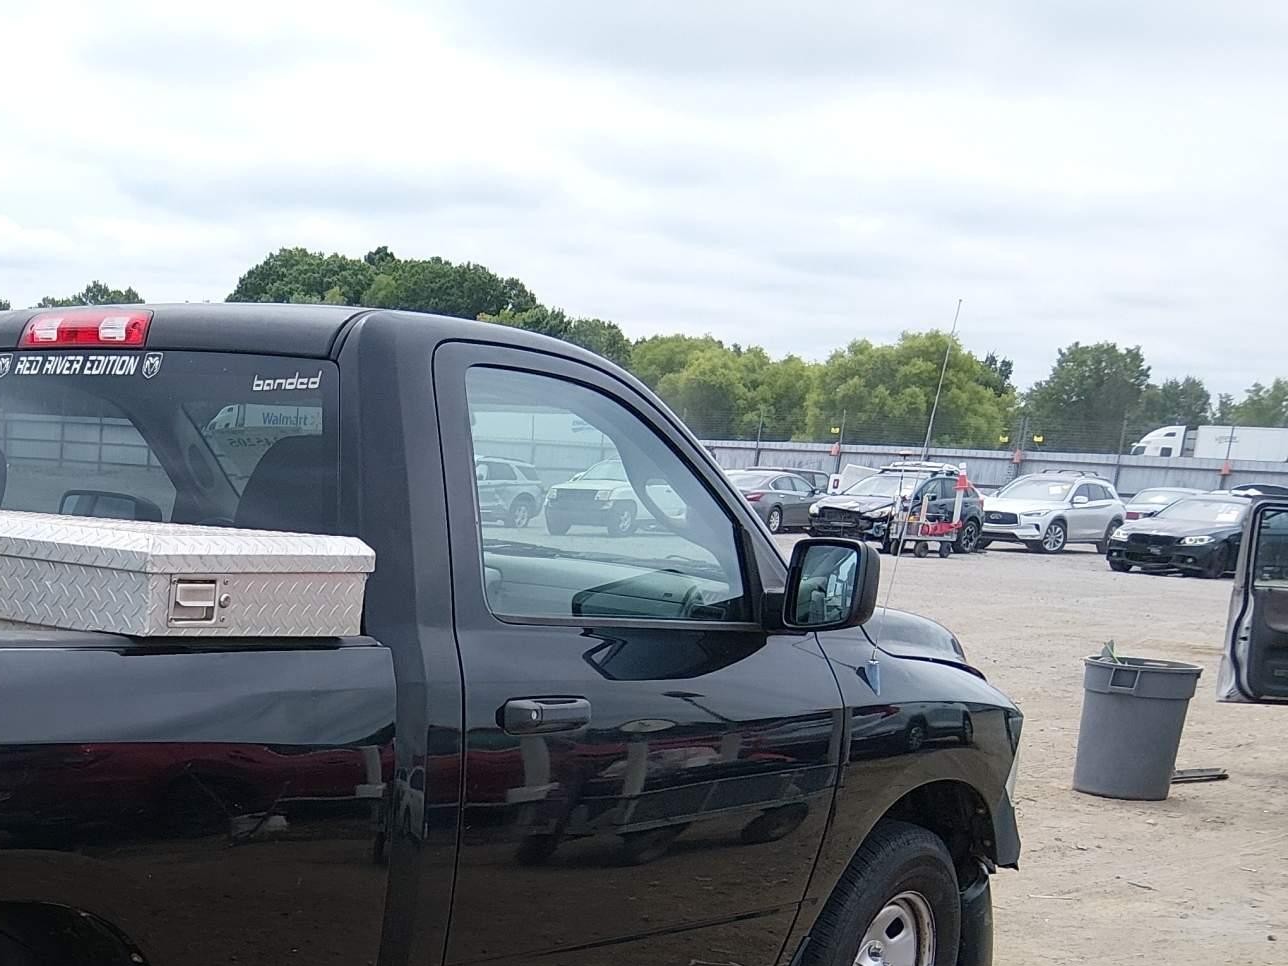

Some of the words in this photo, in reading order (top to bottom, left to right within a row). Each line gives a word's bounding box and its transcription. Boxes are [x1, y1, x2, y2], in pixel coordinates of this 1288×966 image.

[14, 355, 44, 375] RED
[42, 355, 85, 375] RIVER
[83, 355, 140, 376] EDITION
[252, 369, 322, 391] banded
[261, 411, 309, 426] Walmart
